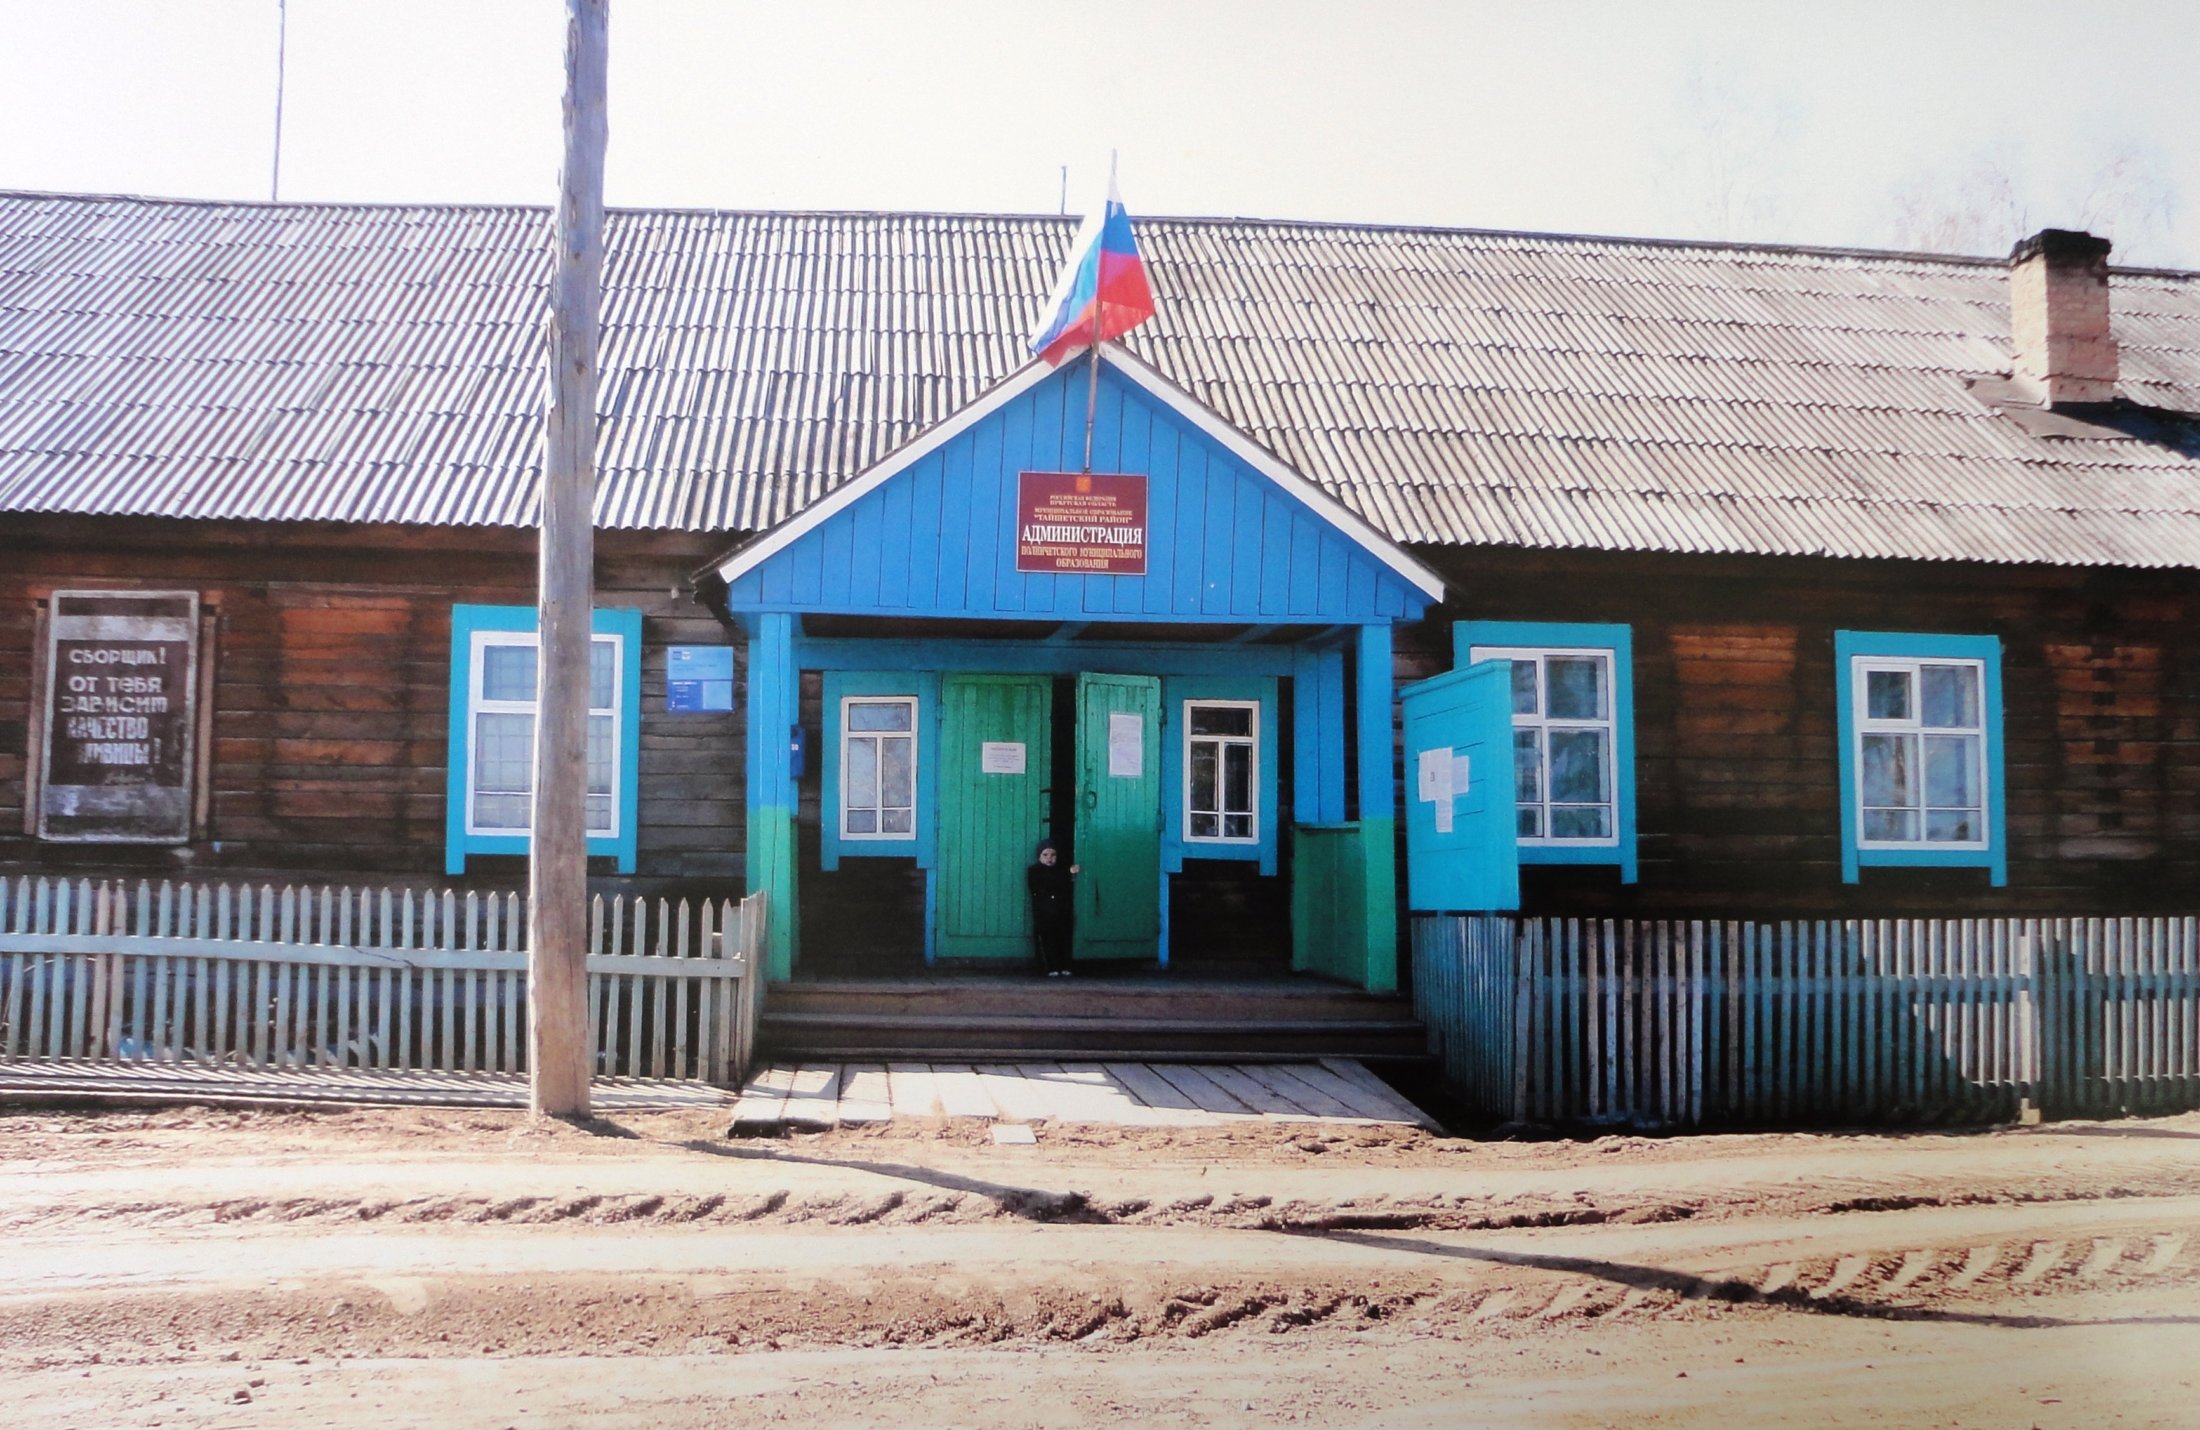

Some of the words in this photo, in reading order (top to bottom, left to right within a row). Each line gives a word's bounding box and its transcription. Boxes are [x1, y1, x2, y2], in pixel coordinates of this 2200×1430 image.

[1099, 516, 1133, 524] РАЙОН"
[1022, 525, 1143, 548] АДМИНИСТРАЦИЯ
[1055, 558, 1109, 569] ОБРАЗОВАНИЯ
[69, 647, 166, 665] СБОРЩИК!
[69, 676, 99, 692] ОТ
